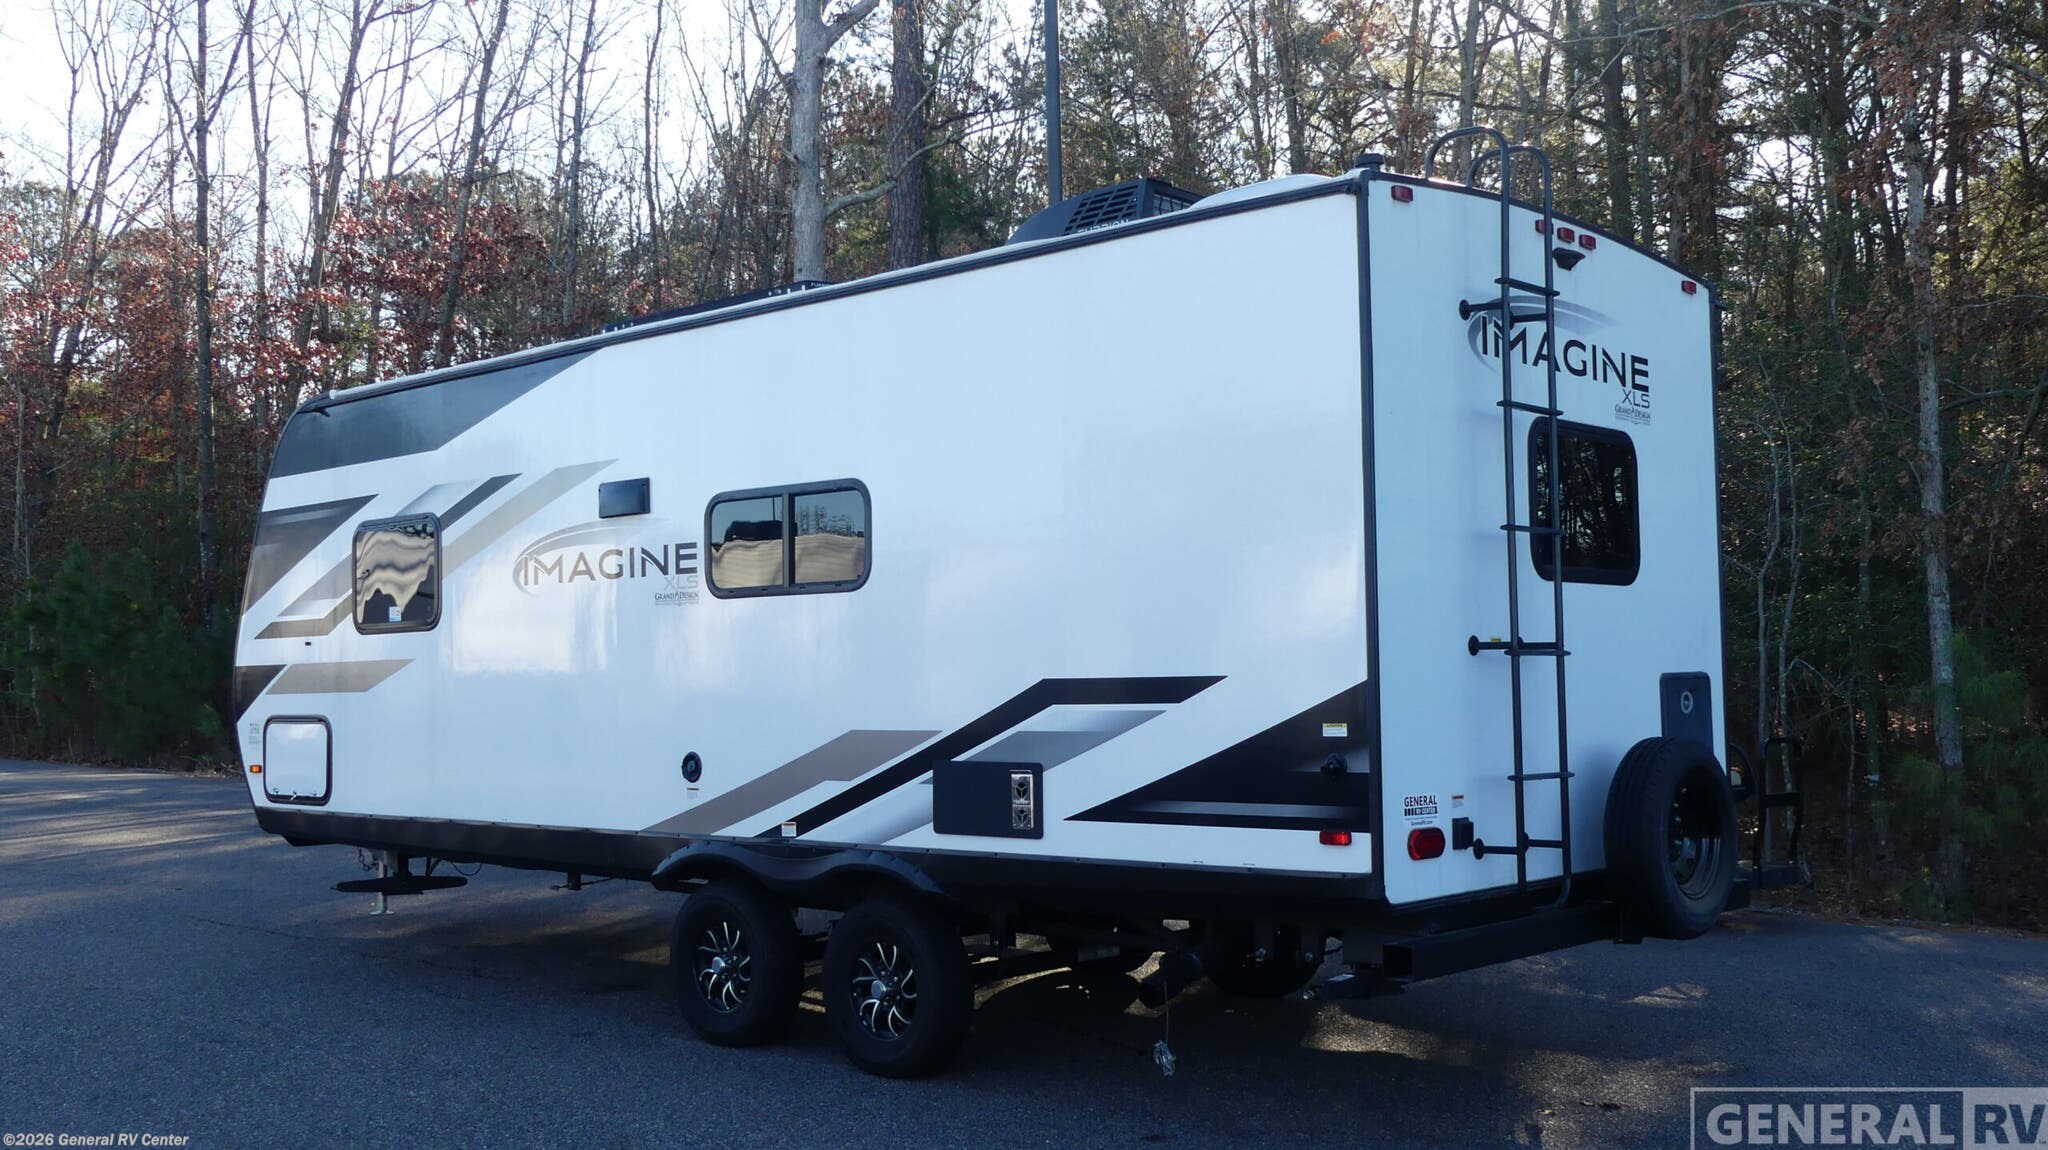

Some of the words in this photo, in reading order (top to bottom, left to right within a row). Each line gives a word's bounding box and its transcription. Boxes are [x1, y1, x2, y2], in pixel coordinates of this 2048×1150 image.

[1481, 315, 1649, 393] IMAGINE
[1622, 389, 1650, 408] XLS
[523, 542, 698, 586] IMAGINE
[663, 575, 699, 591] XLS
[654, 592, 675, 601] GRAND
[679, 591, 699, 599] DESIGN
[1404, 795, 1437, 807] GENERAL
